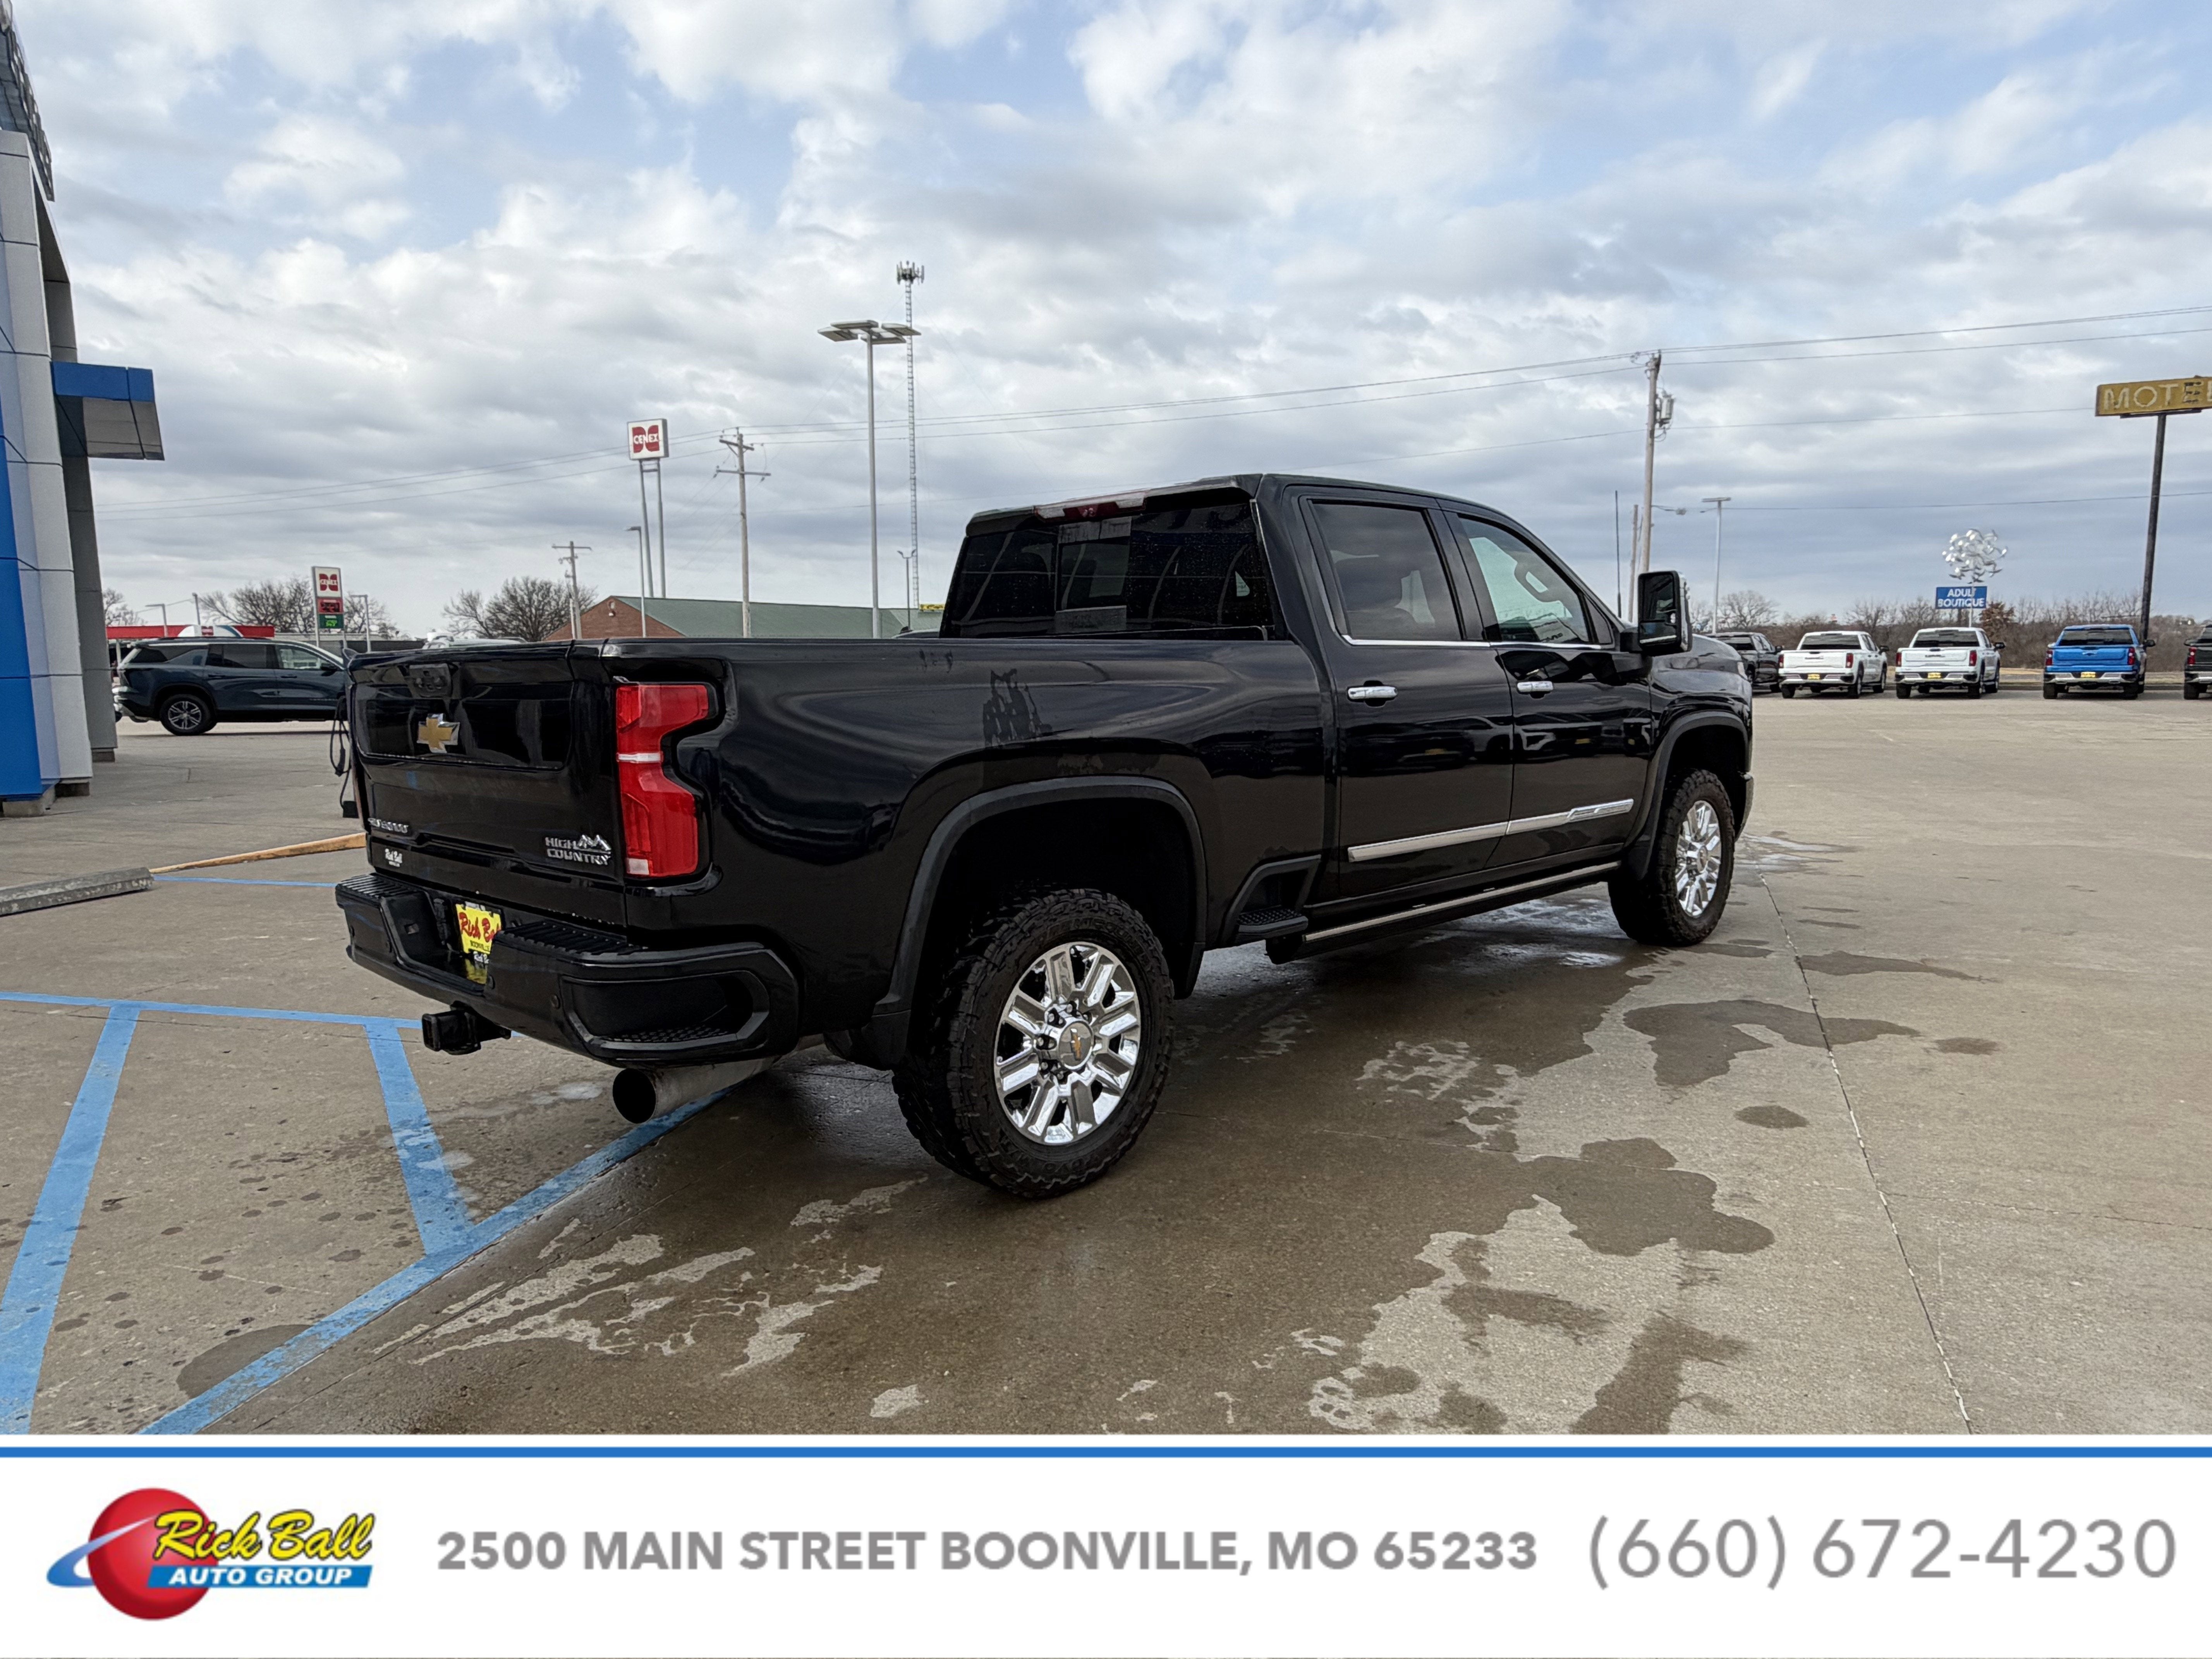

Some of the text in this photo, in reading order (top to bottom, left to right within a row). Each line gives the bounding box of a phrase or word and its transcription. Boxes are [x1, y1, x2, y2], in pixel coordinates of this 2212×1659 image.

[633, 433, 659, 445] CENEX
[545, 837, 577, 850] HIGH
[547, 848, 611, 866] COUNTRY
